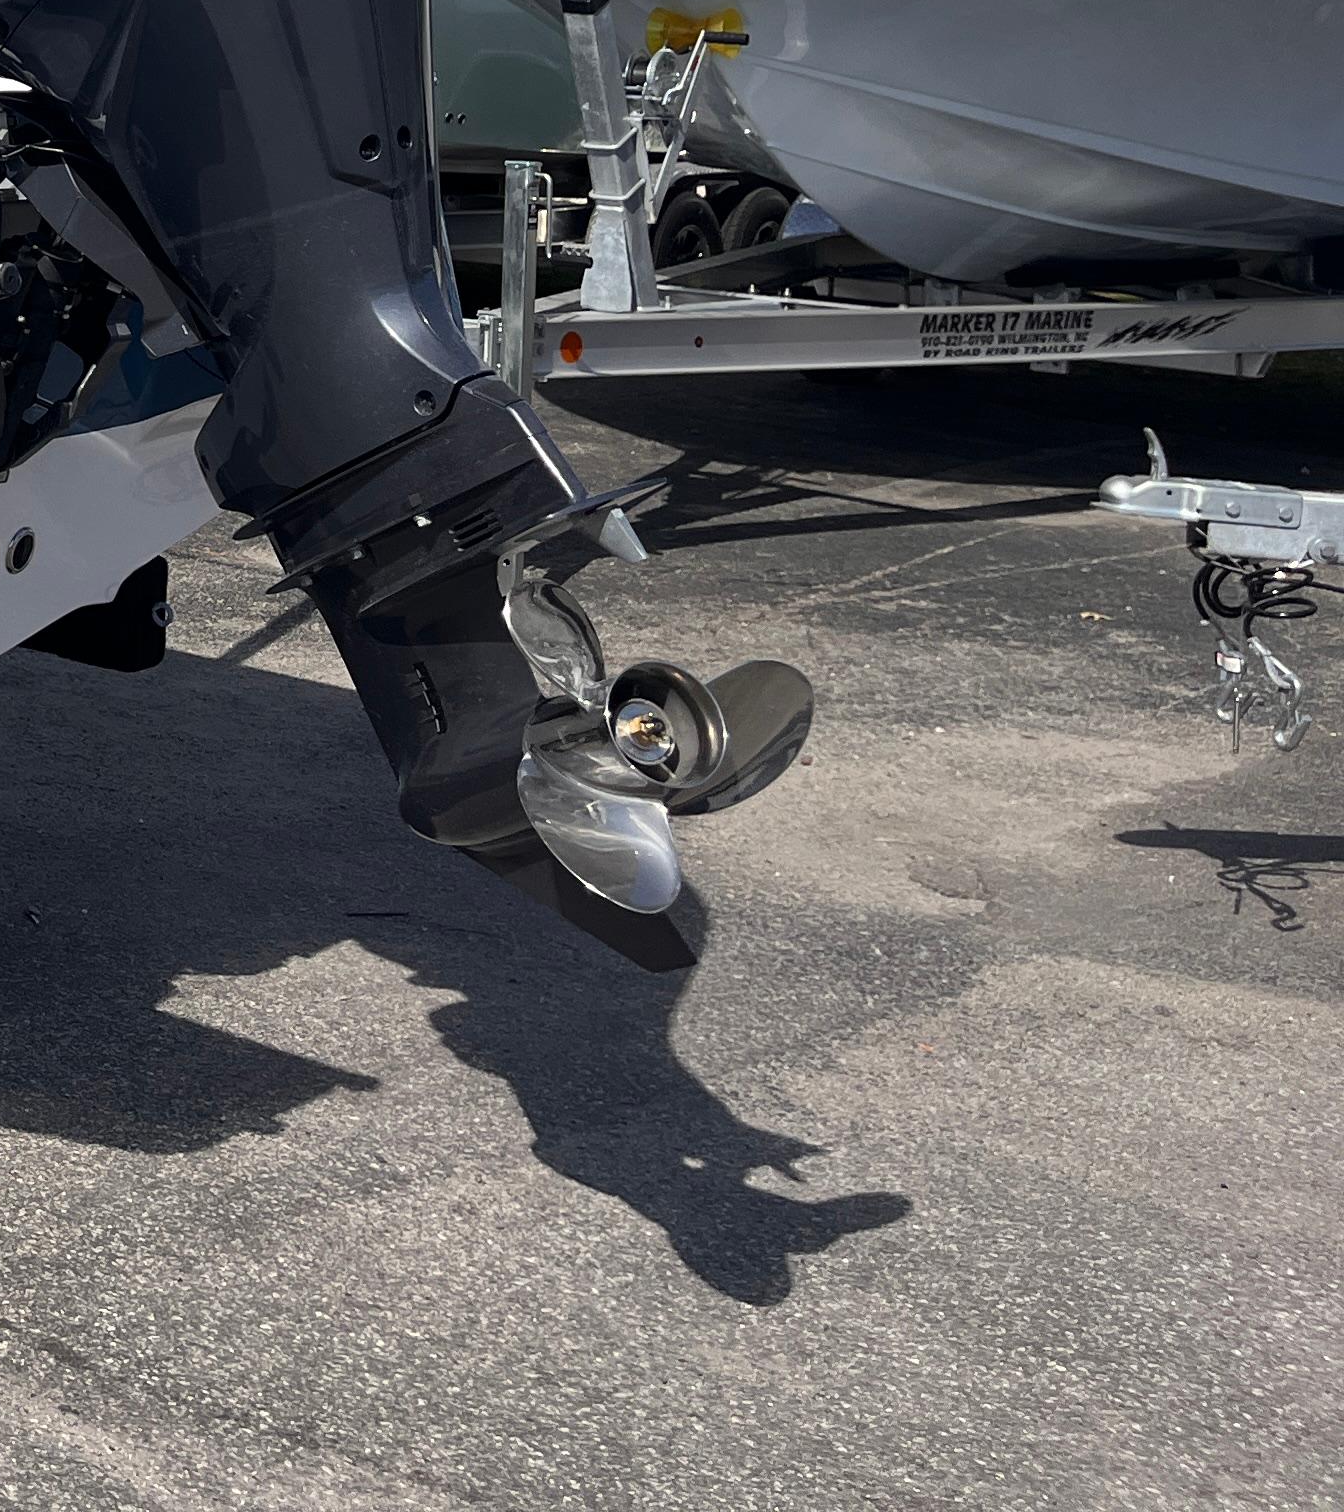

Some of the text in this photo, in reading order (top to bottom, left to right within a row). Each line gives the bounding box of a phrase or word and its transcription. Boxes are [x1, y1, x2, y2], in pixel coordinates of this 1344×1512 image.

[919, 312, 997, 334] MARKER
[1001, 311, 1021, 332] 17
[1024, 310, 1095, 331] MARINE
[923, 344, 1086, 359] BY ROAD KING TRAILERS
